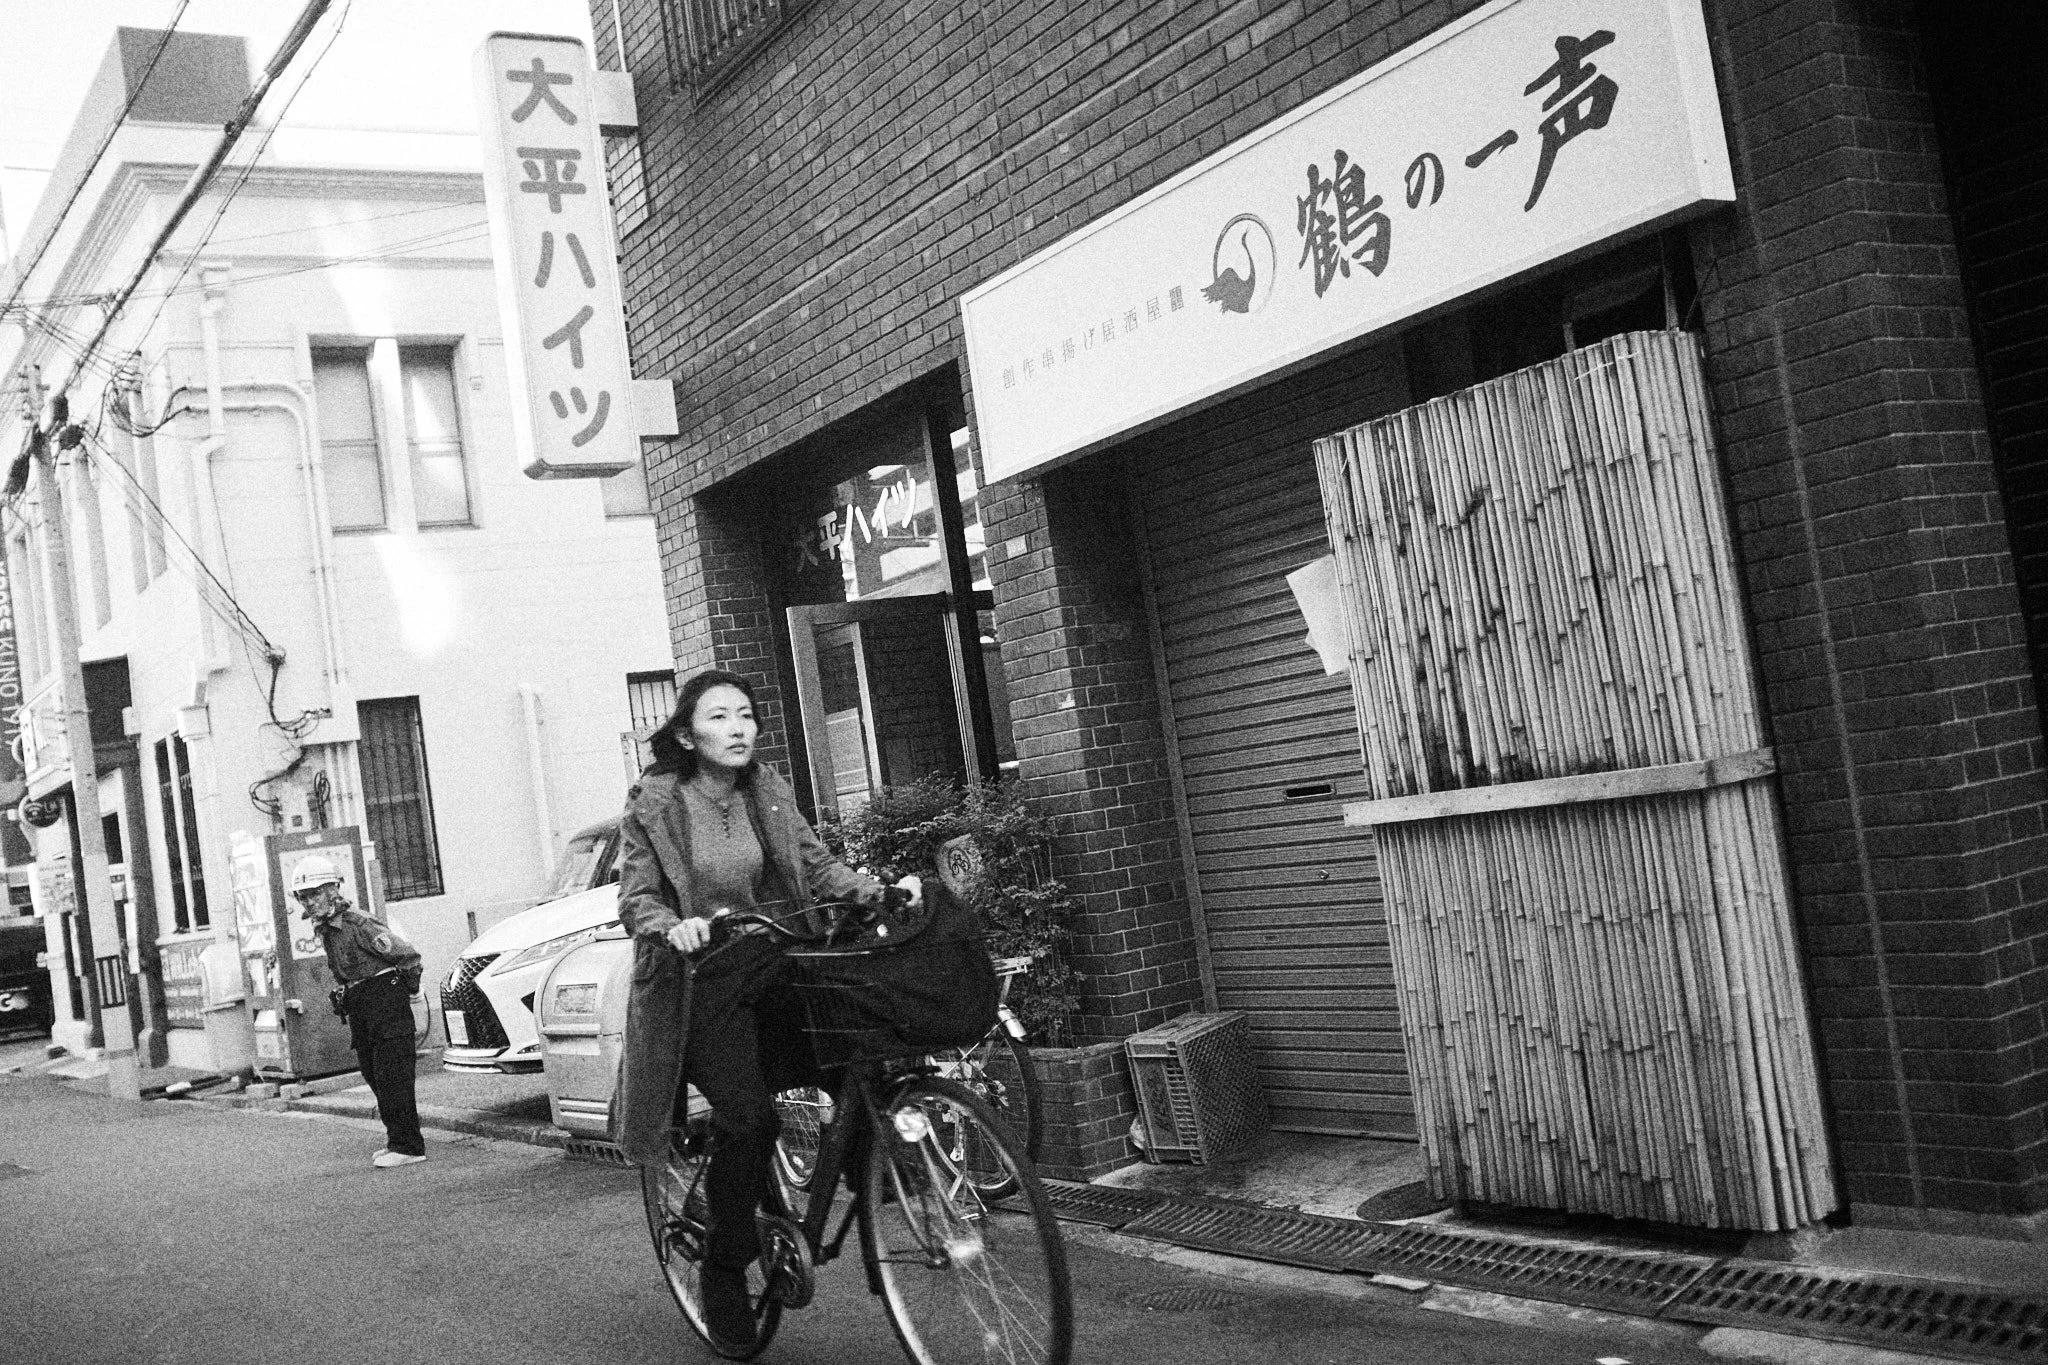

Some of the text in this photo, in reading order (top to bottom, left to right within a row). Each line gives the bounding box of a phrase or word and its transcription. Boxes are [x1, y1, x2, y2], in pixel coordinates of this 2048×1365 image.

[506, 57, 611, 448] 大平ハイツ
[1296, 29, 1619, 299] 鶴の一声
